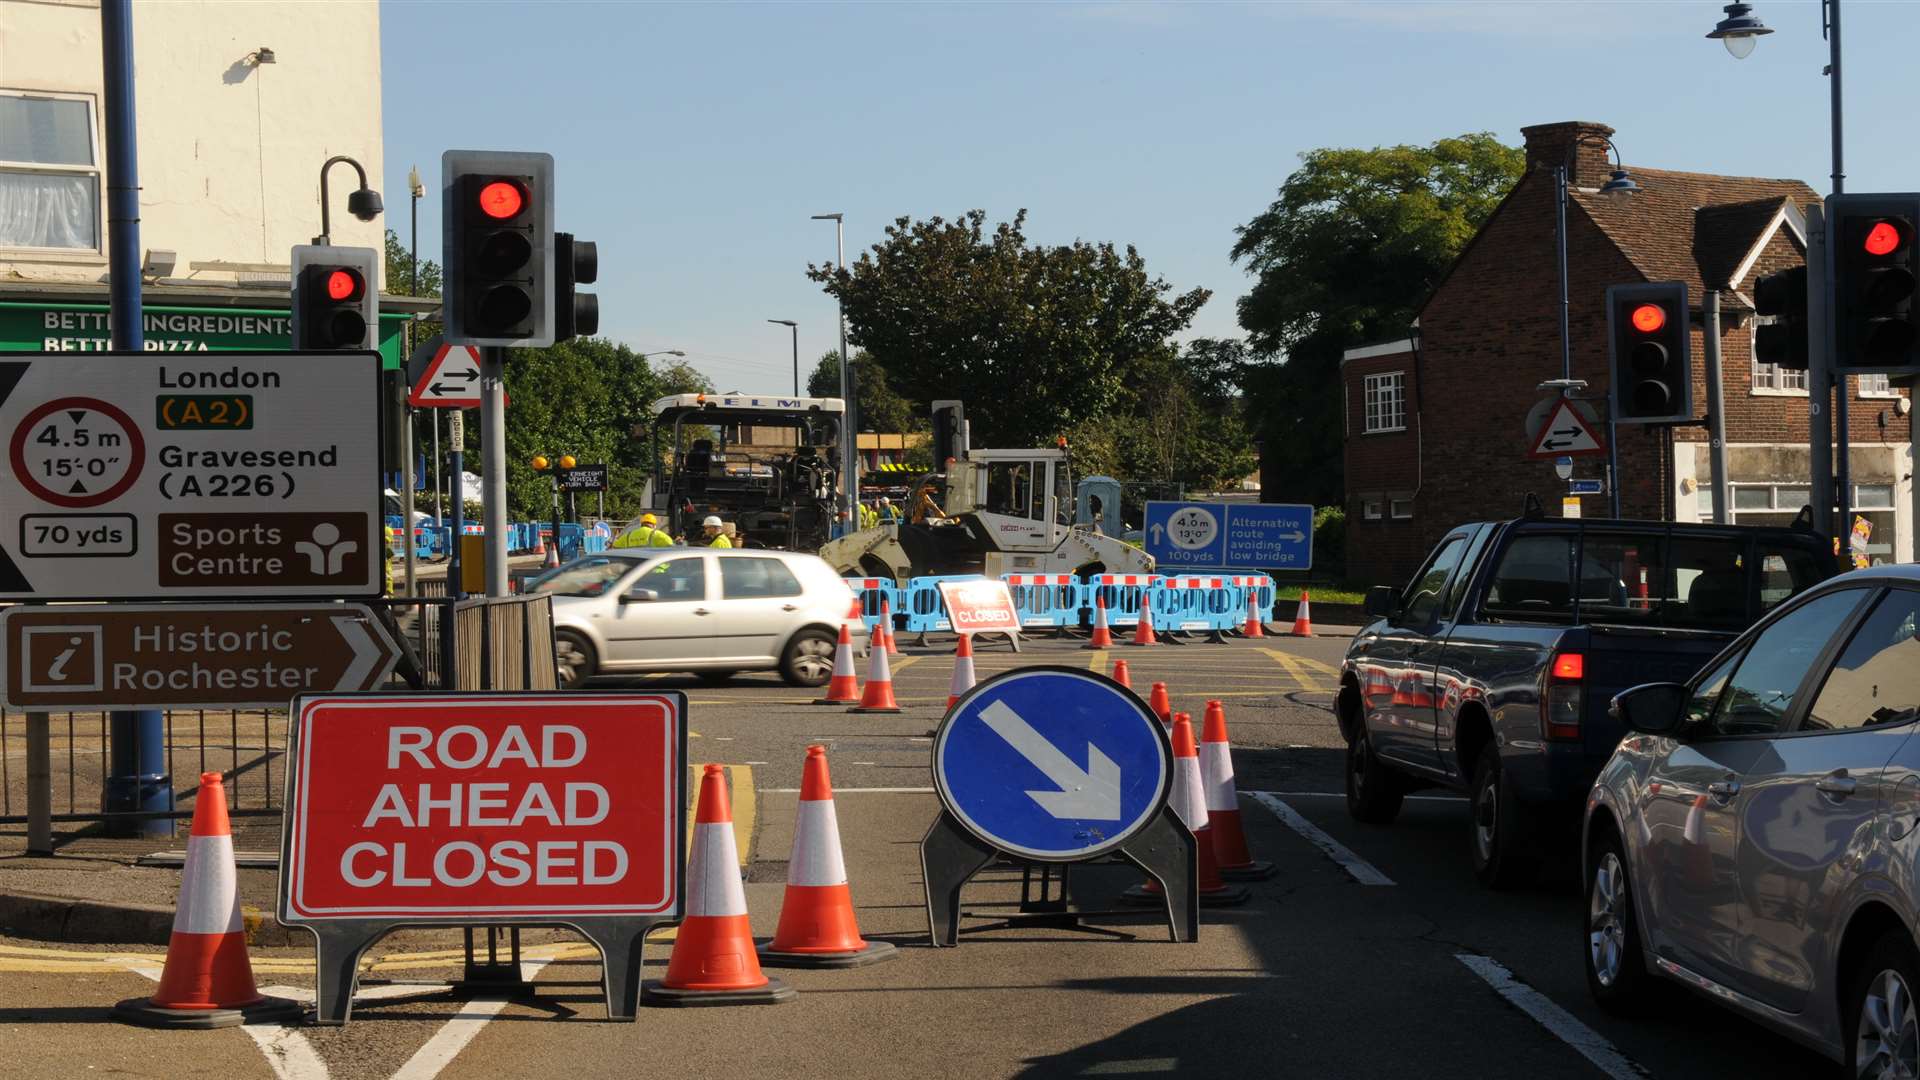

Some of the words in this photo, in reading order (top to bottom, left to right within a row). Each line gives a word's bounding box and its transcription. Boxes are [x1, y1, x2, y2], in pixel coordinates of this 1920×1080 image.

[44, 311, 112, 330] BETT
[159, 366, 282, 389] London
[483, 376, 498, 391] 11
[161, 400, 249, 427] (A2)
[37, 425, 90, 448] 4.5
[98, 431, 121, 448] m
[1712, 438, 1721, 449] 9
[158, 445, 338, 468] Gravesend
[158, 472, 297, 500] (A226)
[1177, 517, 1197, 528] 4.0
[1231, 517, 1300, 529] Alternative
[1231, 529, 1265, 539] route
[34, 525, 70, 546] 70
[77, 524, 123, 554] yds
[172, 522, 283, 551] Sports
[1230, 540, 1282, 552] avoiding
[171, 552, 284, 577] Centre
[1168, 551, 1191, 561] 100
[1193, 551, 1215, 563] yds
[1230, 551, 1252, 561] low
[1255, 551, 1296, 563] bridge
[959, 609, 1011, 623] CLOSED
[134, 623, 294, 653] Historic
[113, 663, 319, 691] Rochester
[387, 724, 588, 770] ROAD
[362, 782, 611, 828] AHEAD
[340, 840, 630, 888] CLOSED
